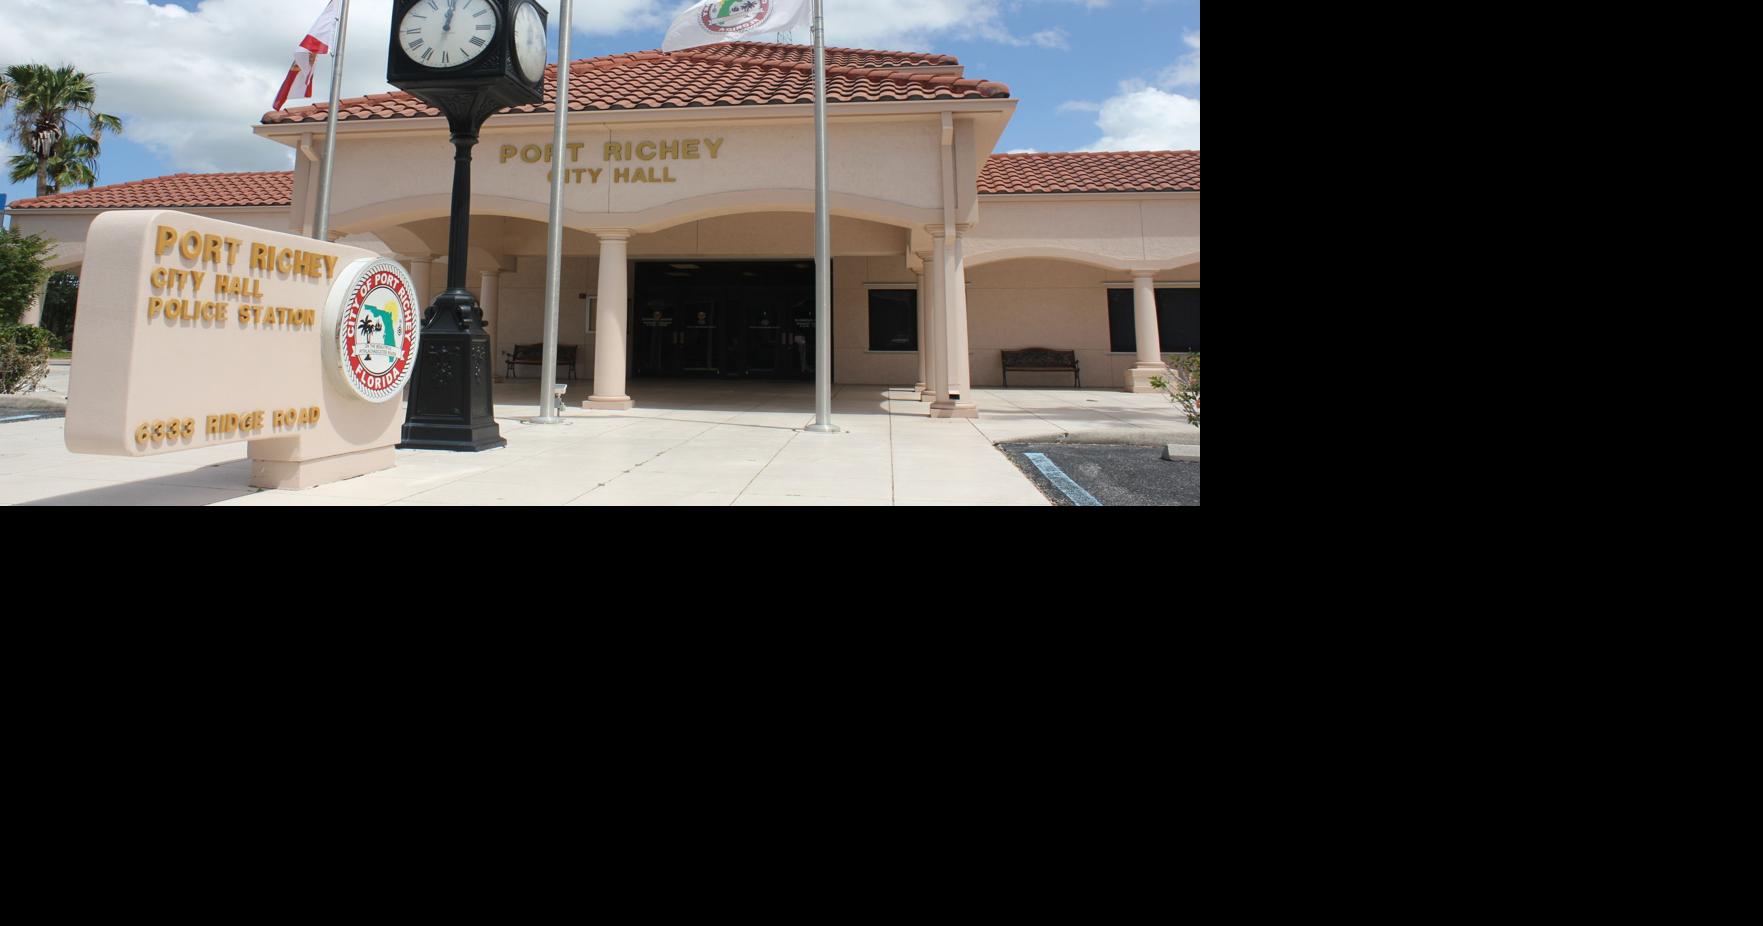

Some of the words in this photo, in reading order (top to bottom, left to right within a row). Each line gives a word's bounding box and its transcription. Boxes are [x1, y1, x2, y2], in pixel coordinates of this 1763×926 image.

[602, 137, 724, 162] RICHEY
[546, 167, 603, 184] ITY
[613, 166, 677, 184] HALL
[155, 224, 244, 266] PORT
[250, 241, 339, 280] RICHEY
[150, 266, 206, 292] CITY
[214, 273, 264, 299] HALL
[147, 296, 229, 322] POLICE
[237, 303, 316, 328] STATION
[347, 298, 361, 338] CITY
[359, 280, 373, 296] OF
[374, 272, 399, 288] PORT
[397, 286, 412, 343] RICHEY
[355, 365, 400, 389] FLORIDA
[134, 416, 196, 446] 6333
[205, 410, 265, 434] RIDGE
[271, 406, 321, 429] ROAD
